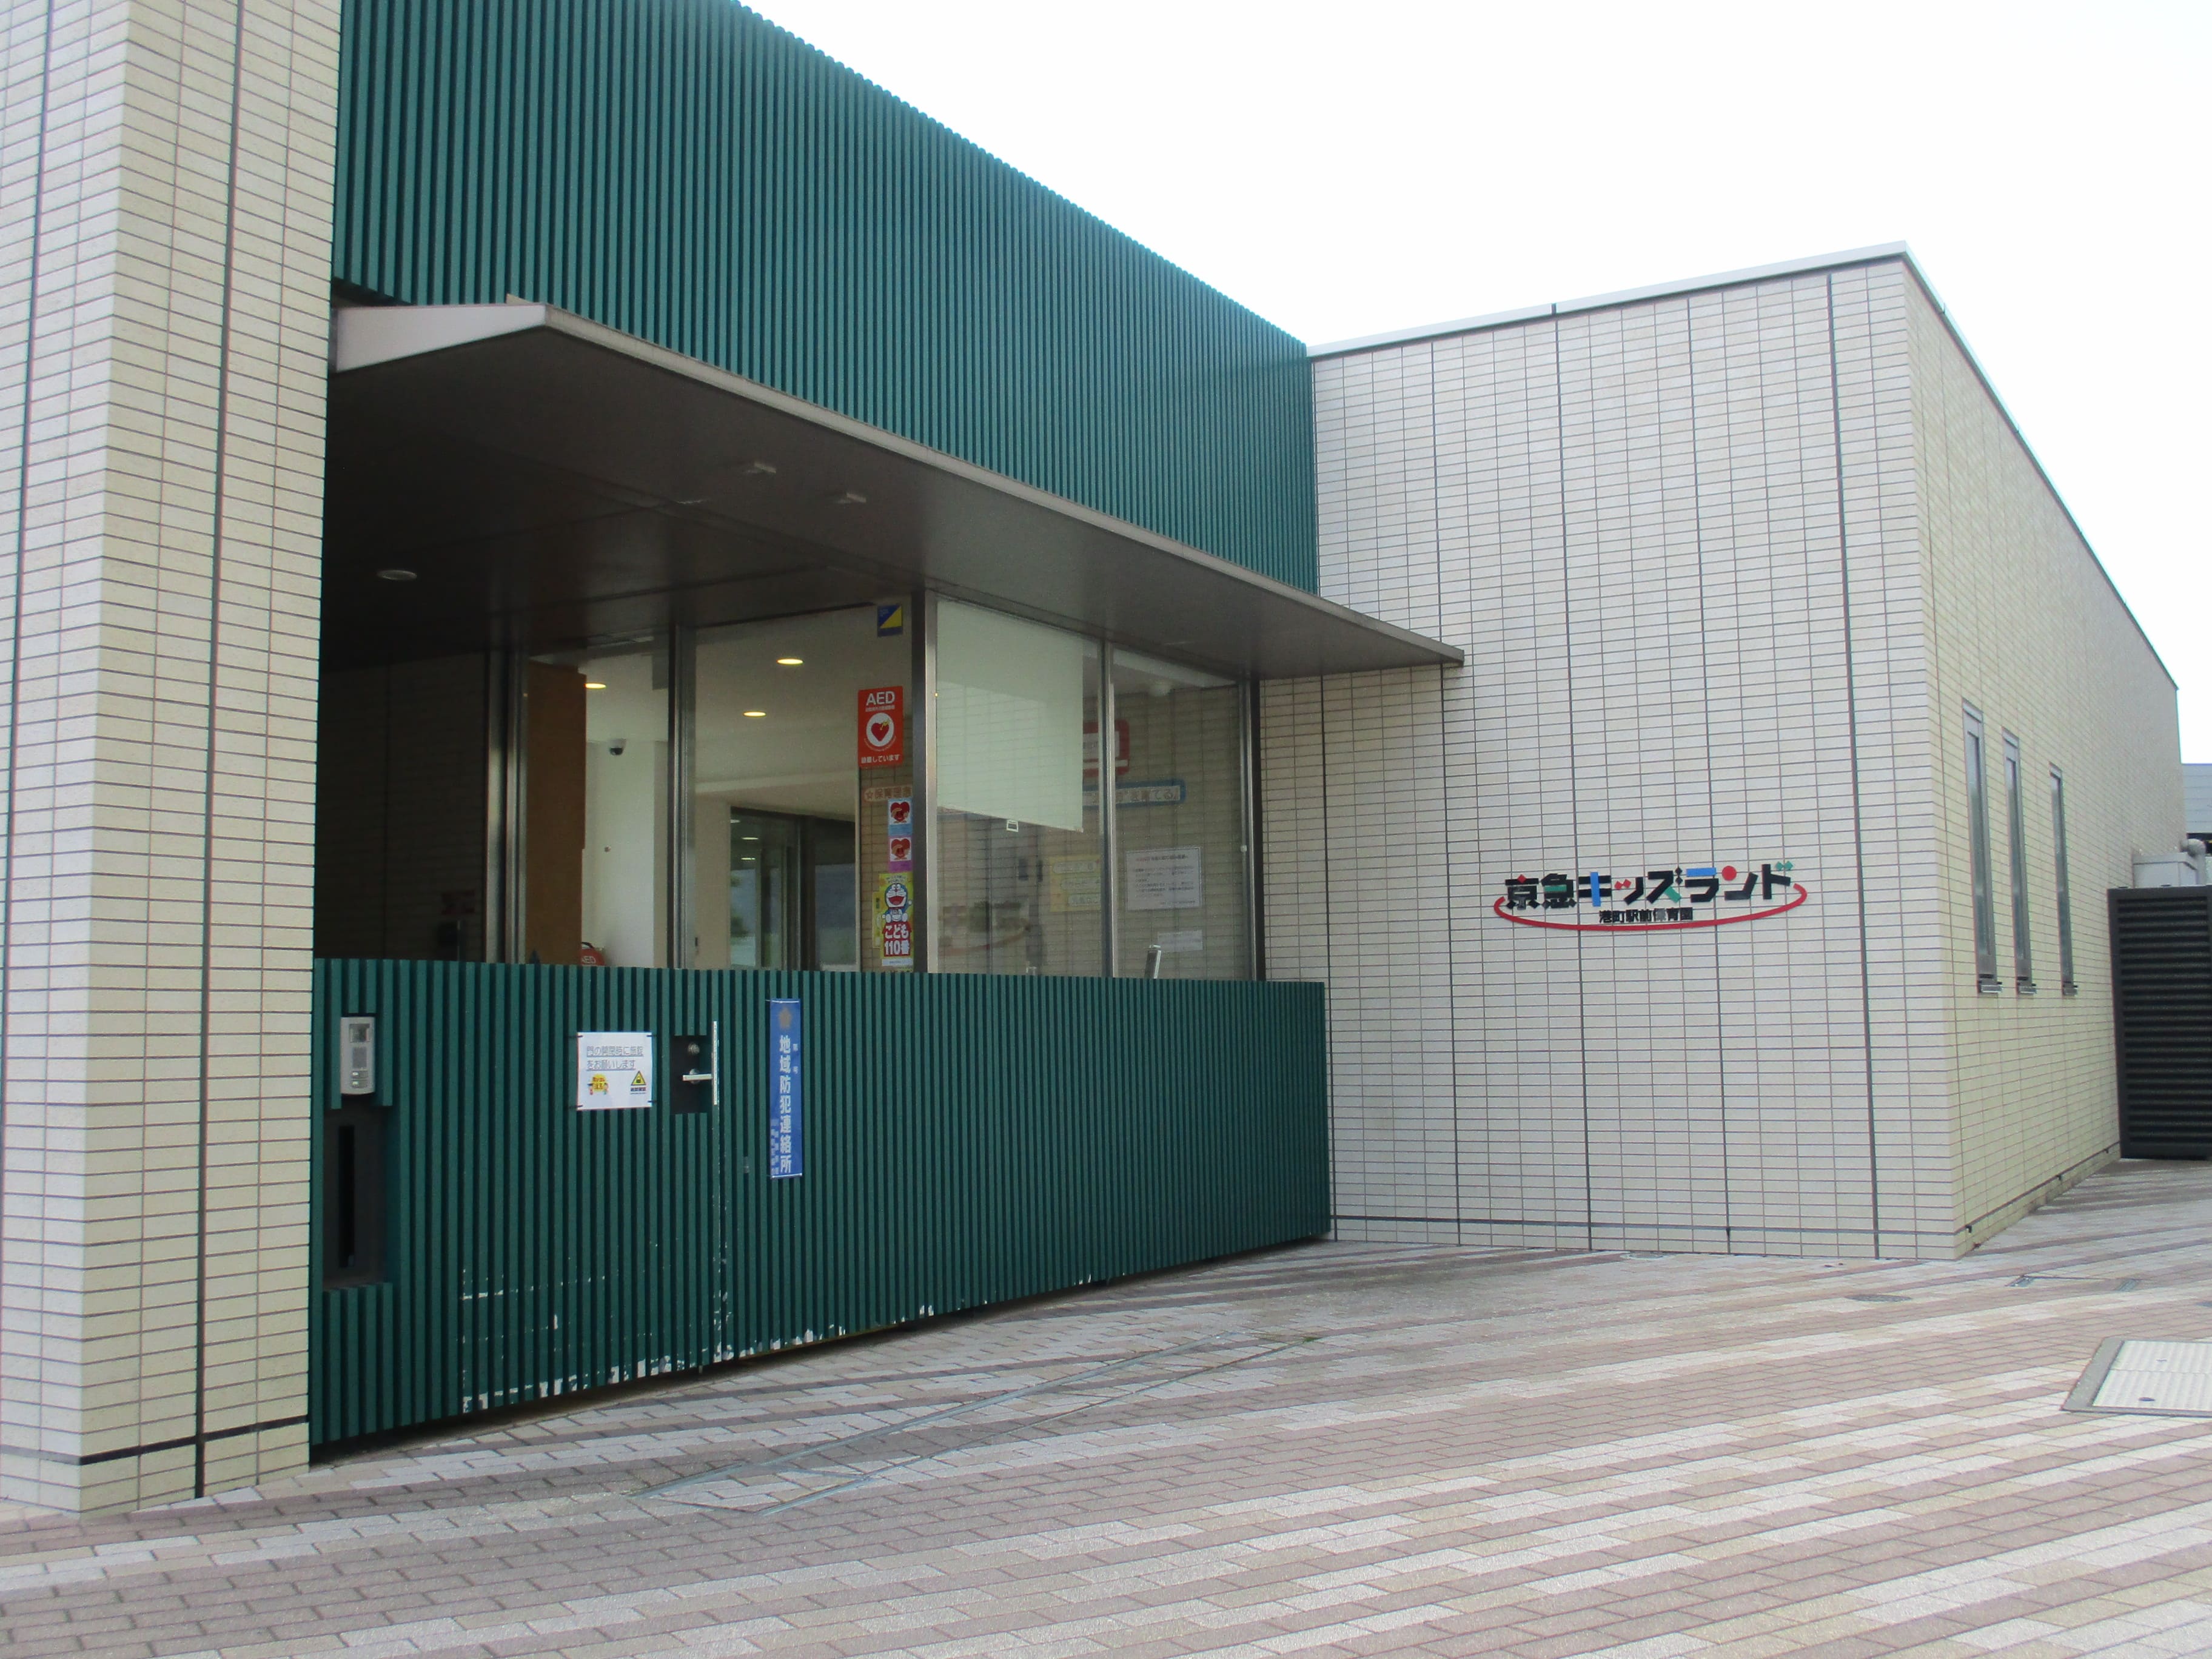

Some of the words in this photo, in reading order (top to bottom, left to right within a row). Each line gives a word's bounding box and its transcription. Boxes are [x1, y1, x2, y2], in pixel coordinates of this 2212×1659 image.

[866, 691, 896, 705] AED
[1505, 860, 1794, 909] 京急キッズランド
[885, 923, 909, 939] こども
[884, 939, 910, 956] 110番
[586, 1059, 636, 1070] をお願いします
[779, 1034, 792, 1173] 地域防犯連絡所
